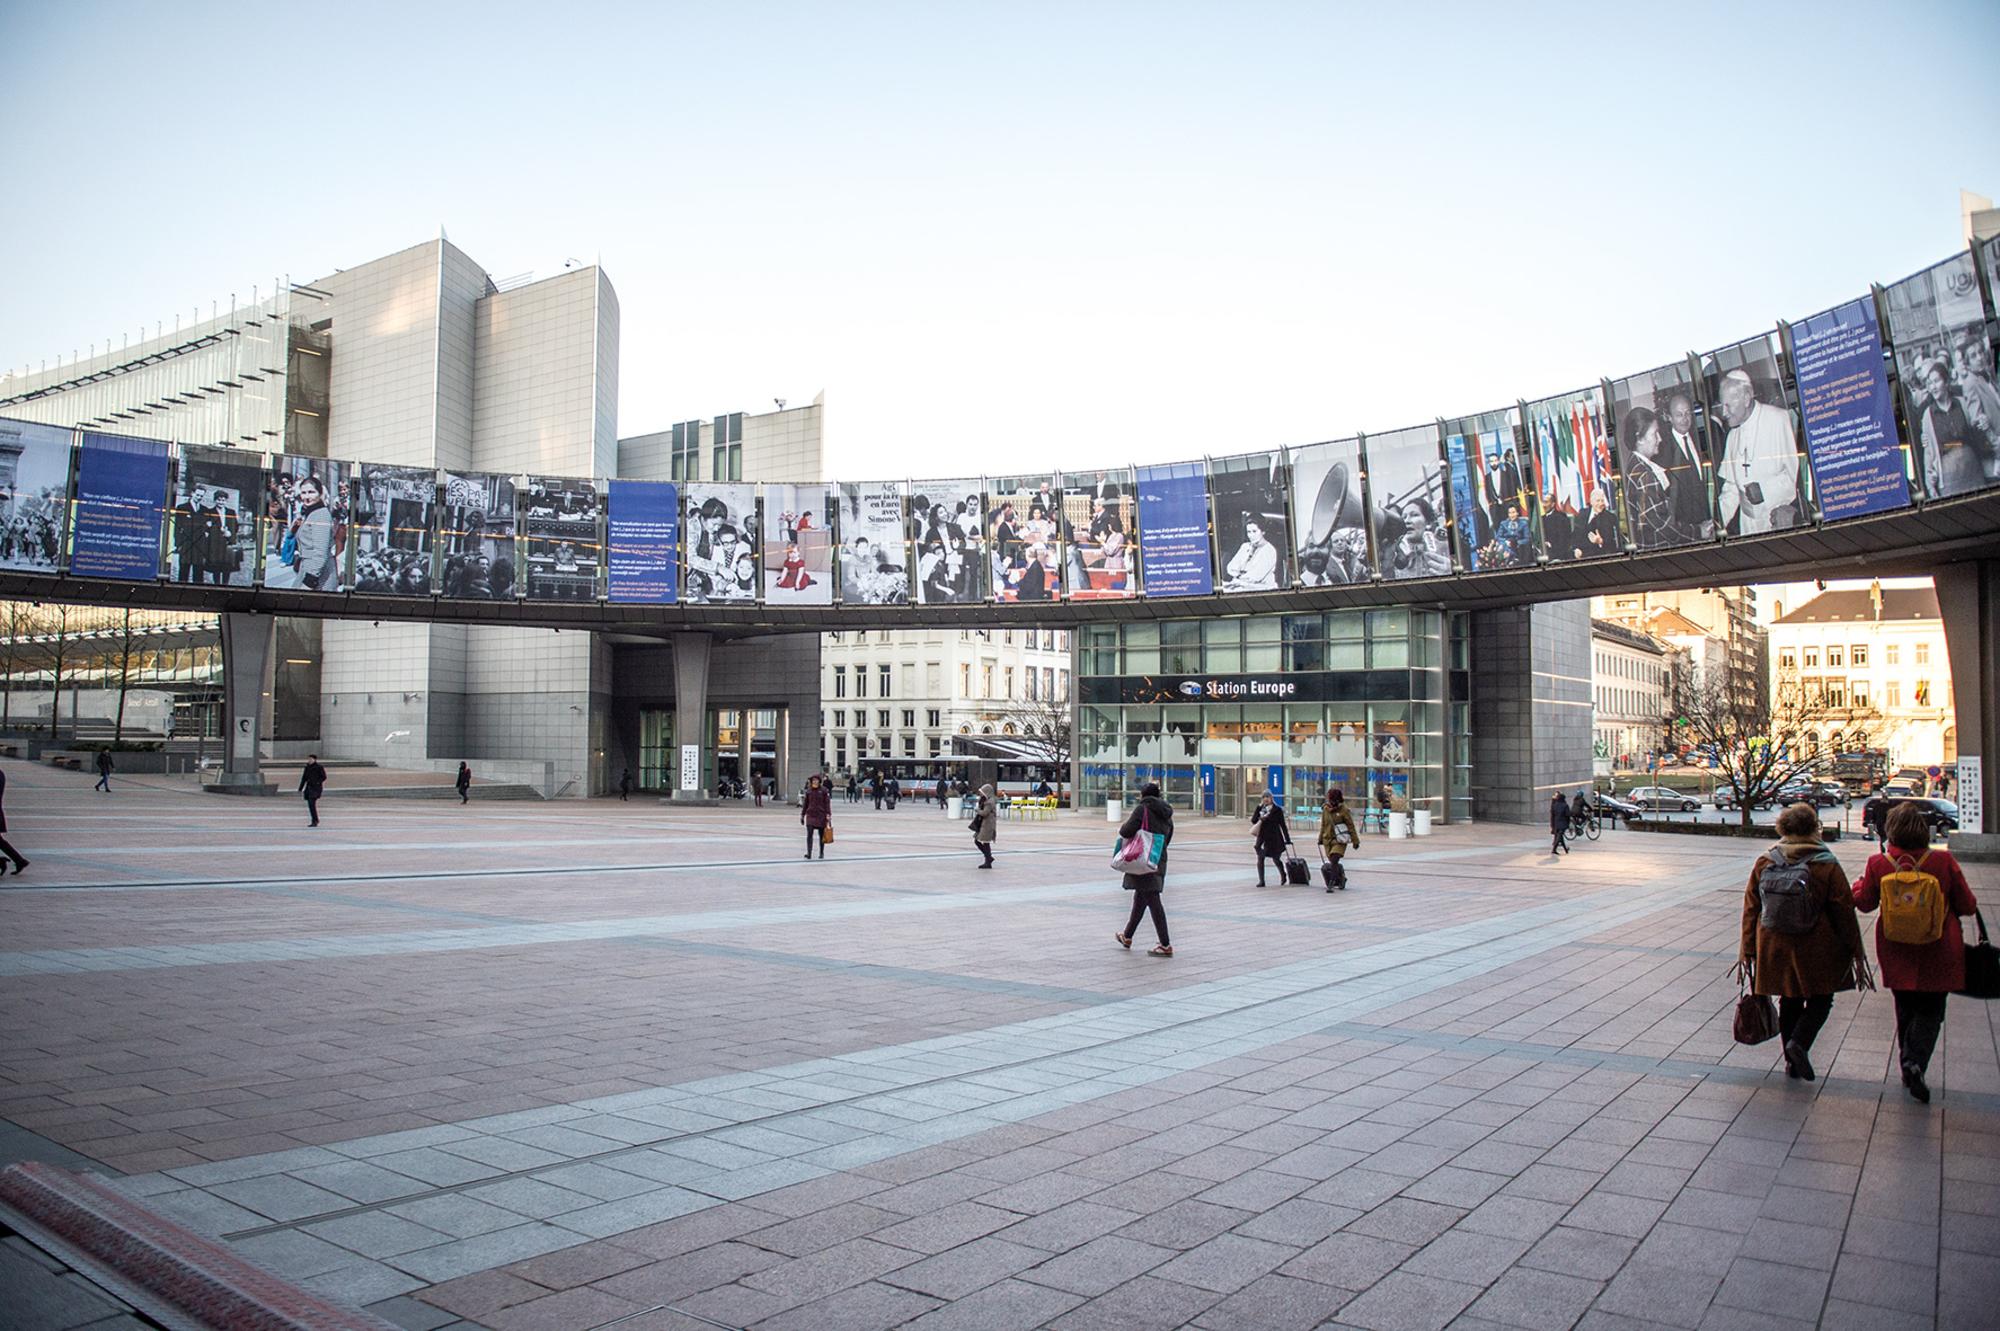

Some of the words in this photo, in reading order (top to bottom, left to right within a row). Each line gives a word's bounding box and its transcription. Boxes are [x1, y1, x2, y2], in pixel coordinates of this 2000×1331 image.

[1206, 681, 1246, 694] Station
[1250, 681, 1294, 697] Europe
[1084, 765, 1128, 777] Welcome
